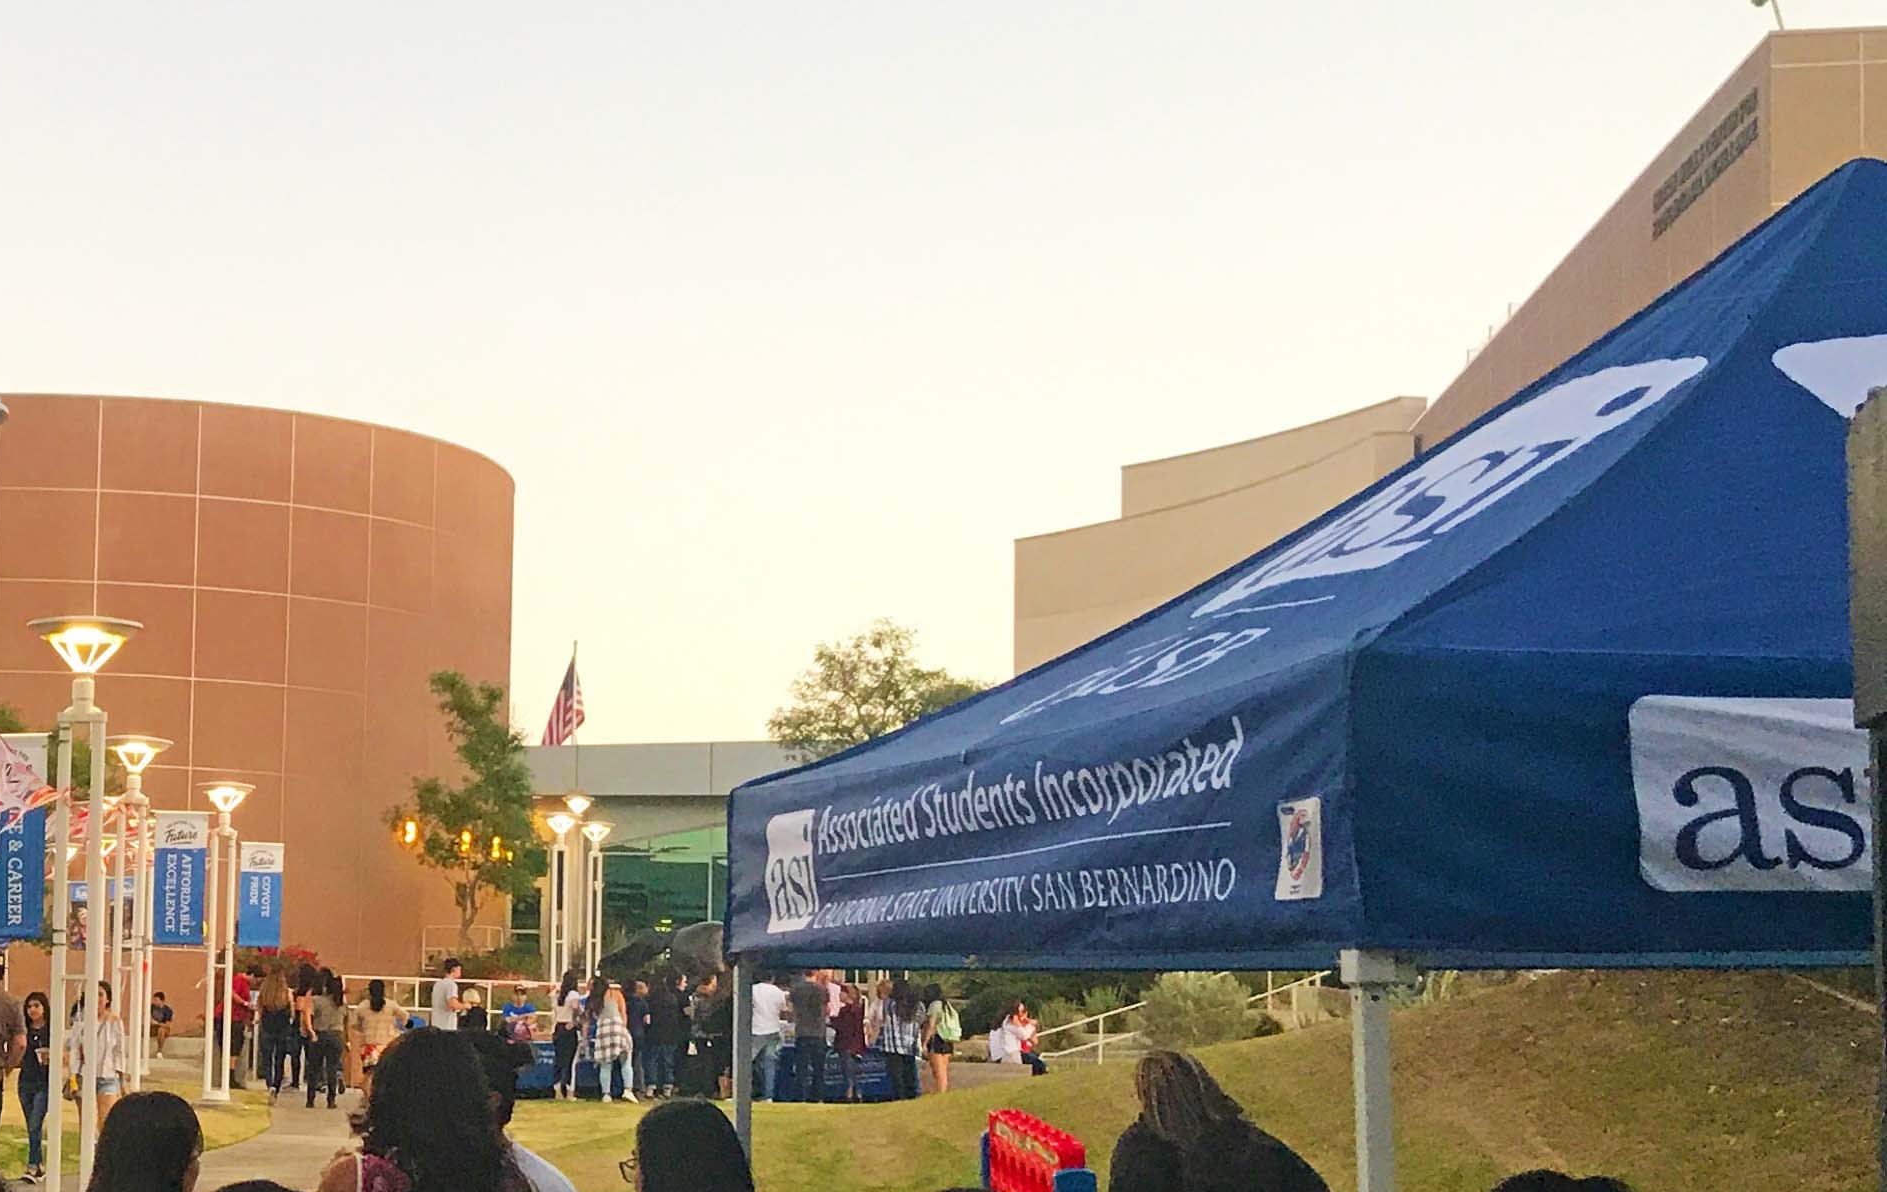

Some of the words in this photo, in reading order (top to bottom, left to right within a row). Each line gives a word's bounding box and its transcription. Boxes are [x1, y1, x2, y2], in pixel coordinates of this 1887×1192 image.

[818, 786, 921, 855] Associated
[920, 770, 1037, 838] Students
[1035, 716, 1245, 826] Incorporated
[1673, 766, 1871, 870] as
[8, 839, 24, 853] &
[770, 824, 816, 921] asi
[8, 857, 24, 926] CAREER
[165, 853, 177, 933] EXCELLENCE
[180, 853, 193, 936] AFFORDABLE
[249, 875, 259, 906] PRIDE
[260, 875, 272, 918] COYOTE
[887, 888, 937, 921] STATE
[931, 875, 1028, 919] UNIVERSITY,
[1031, 871, 1076, 912] SAN
[1080, 858, 1236, 909] BERNARDINO
